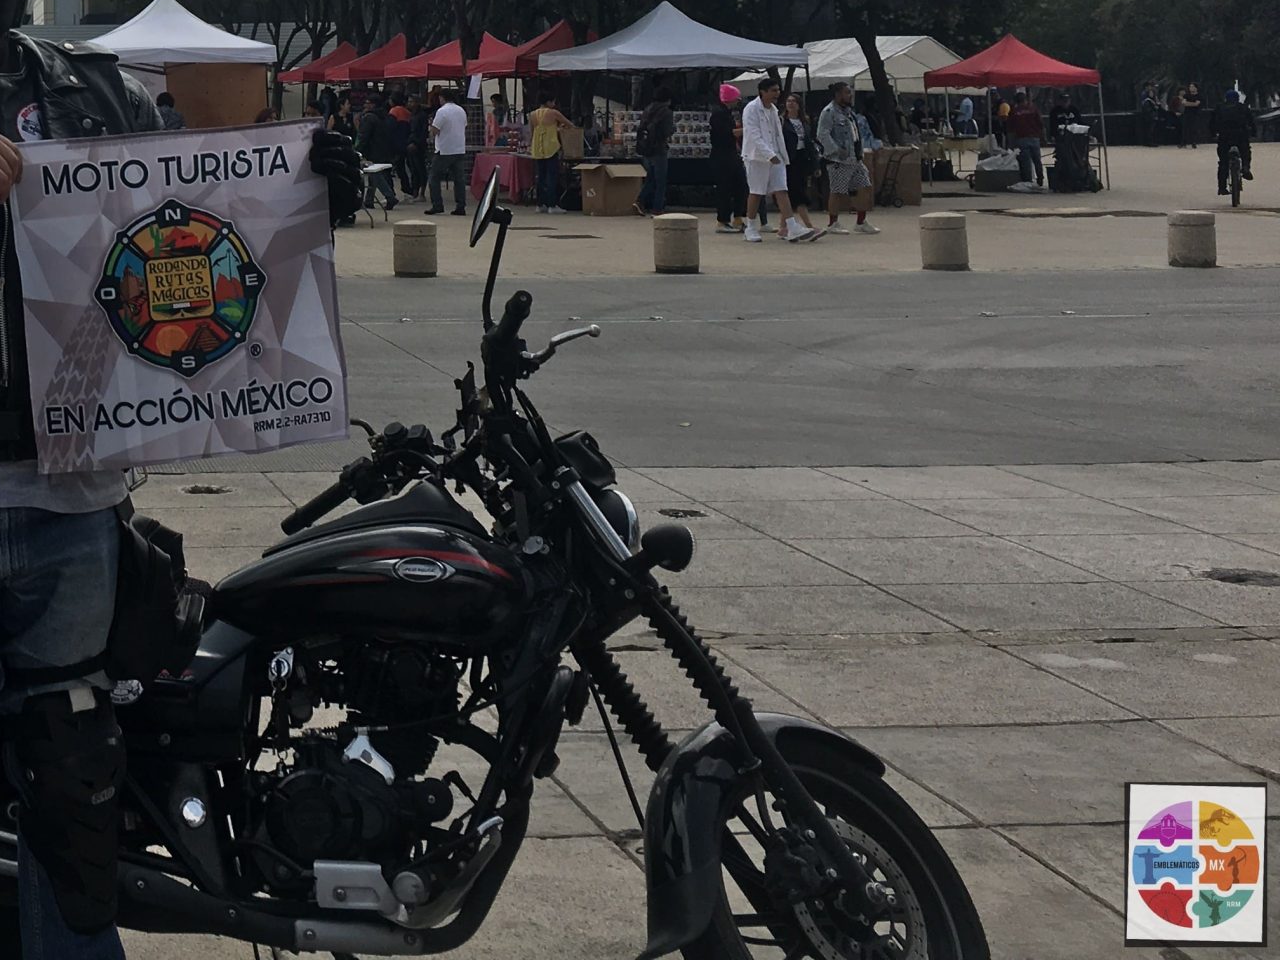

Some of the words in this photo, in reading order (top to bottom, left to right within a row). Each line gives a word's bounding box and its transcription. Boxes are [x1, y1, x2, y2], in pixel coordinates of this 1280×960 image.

[41, 158, 150, 196] MOTO
[157, 144, 291, 187] TURISTA
[164, 207, 182, 222] N
[244, 273, 259, 286] E
[100, 287, 117, 301] O
[181, 355, 196, 369] S
[45, 404, 86, 435] EN
[93, 387, 215, 432] ACCIÓN
[221, 377, 333, 419] MÉXICO
